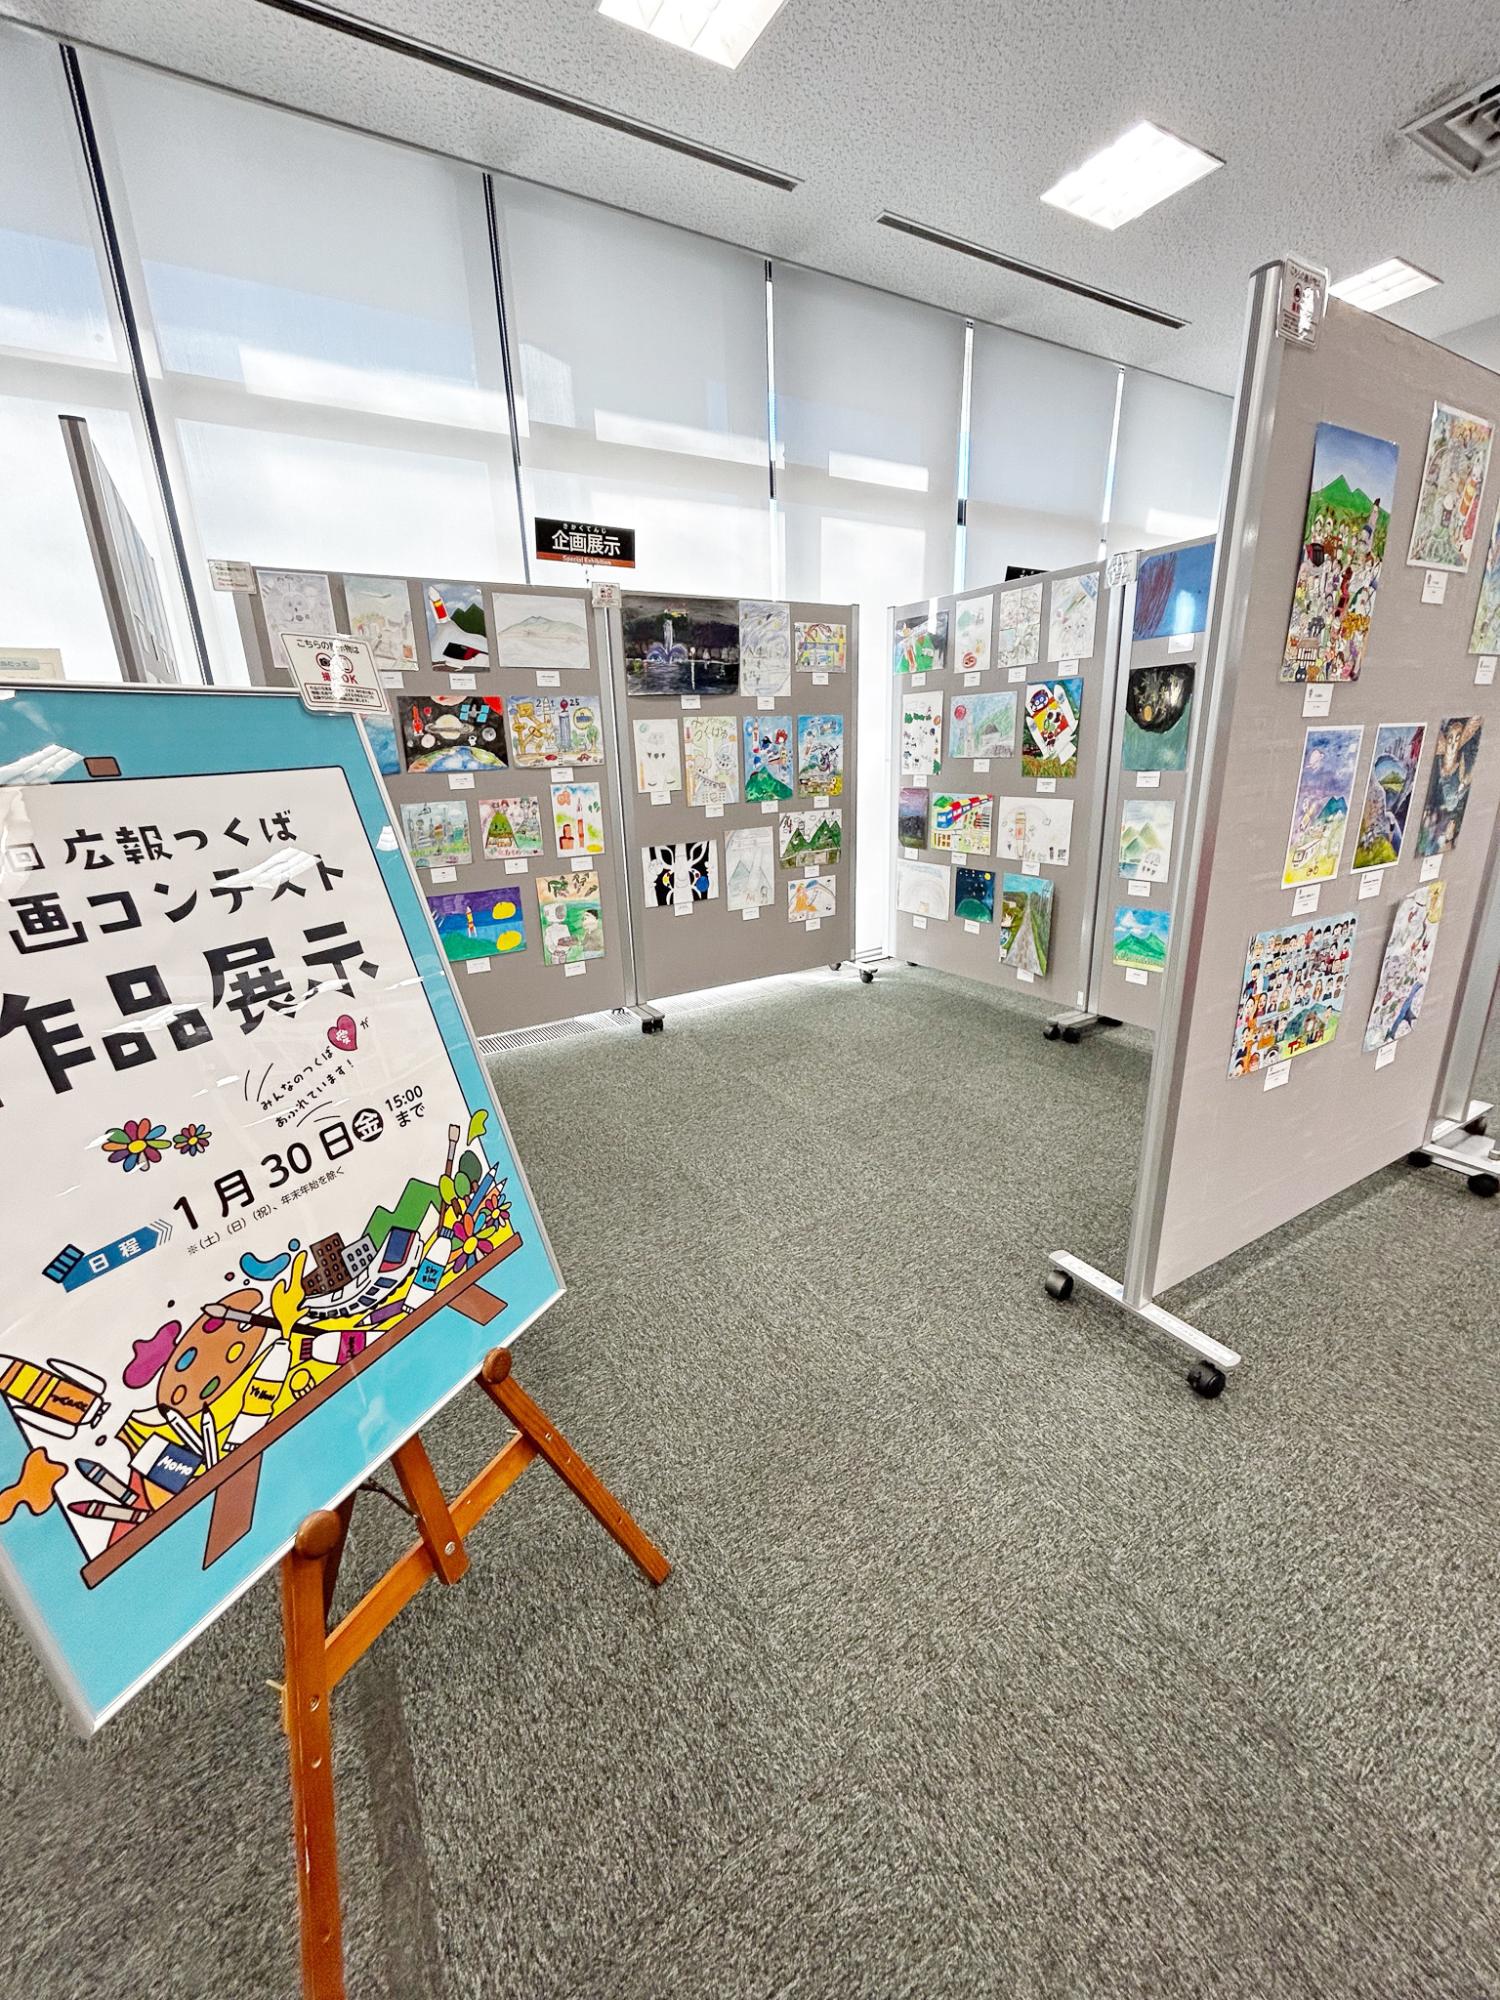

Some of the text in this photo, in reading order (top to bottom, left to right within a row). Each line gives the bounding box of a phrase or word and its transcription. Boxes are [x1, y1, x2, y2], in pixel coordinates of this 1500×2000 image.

[551, 529, 621, 556] 企画展示
[63, 809, 299, 871] 広報つくば
[384, 1085, 423, 1112] 15:00
[395, 1102, 426, 1128] まで
[88, 1236, 141, 1273] 日程
